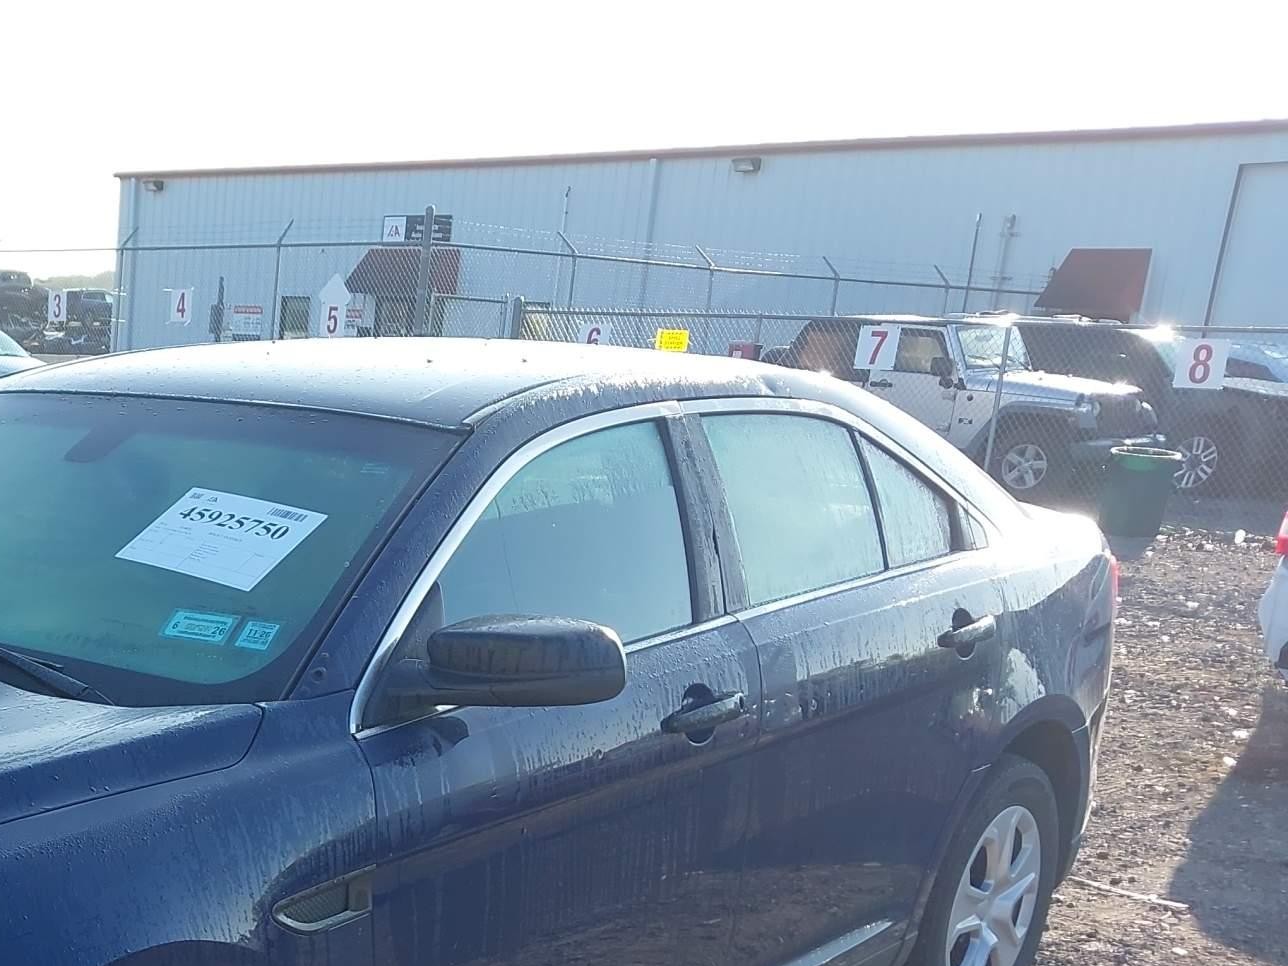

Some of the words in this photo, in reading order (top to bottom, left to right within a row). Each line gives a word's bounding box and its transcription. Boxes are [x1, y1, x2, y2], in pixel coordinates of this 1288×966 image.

[52, 295, 62, 317] 3
[176, 292, 185, 318] 4
[326, 305, 338, 335] 5
[869, 331, 888, 365] 7
[1188, 343, 1214, 384] 8
[180, 506, 290, 541] 45925750
[211, 626, 226, 636] 26
